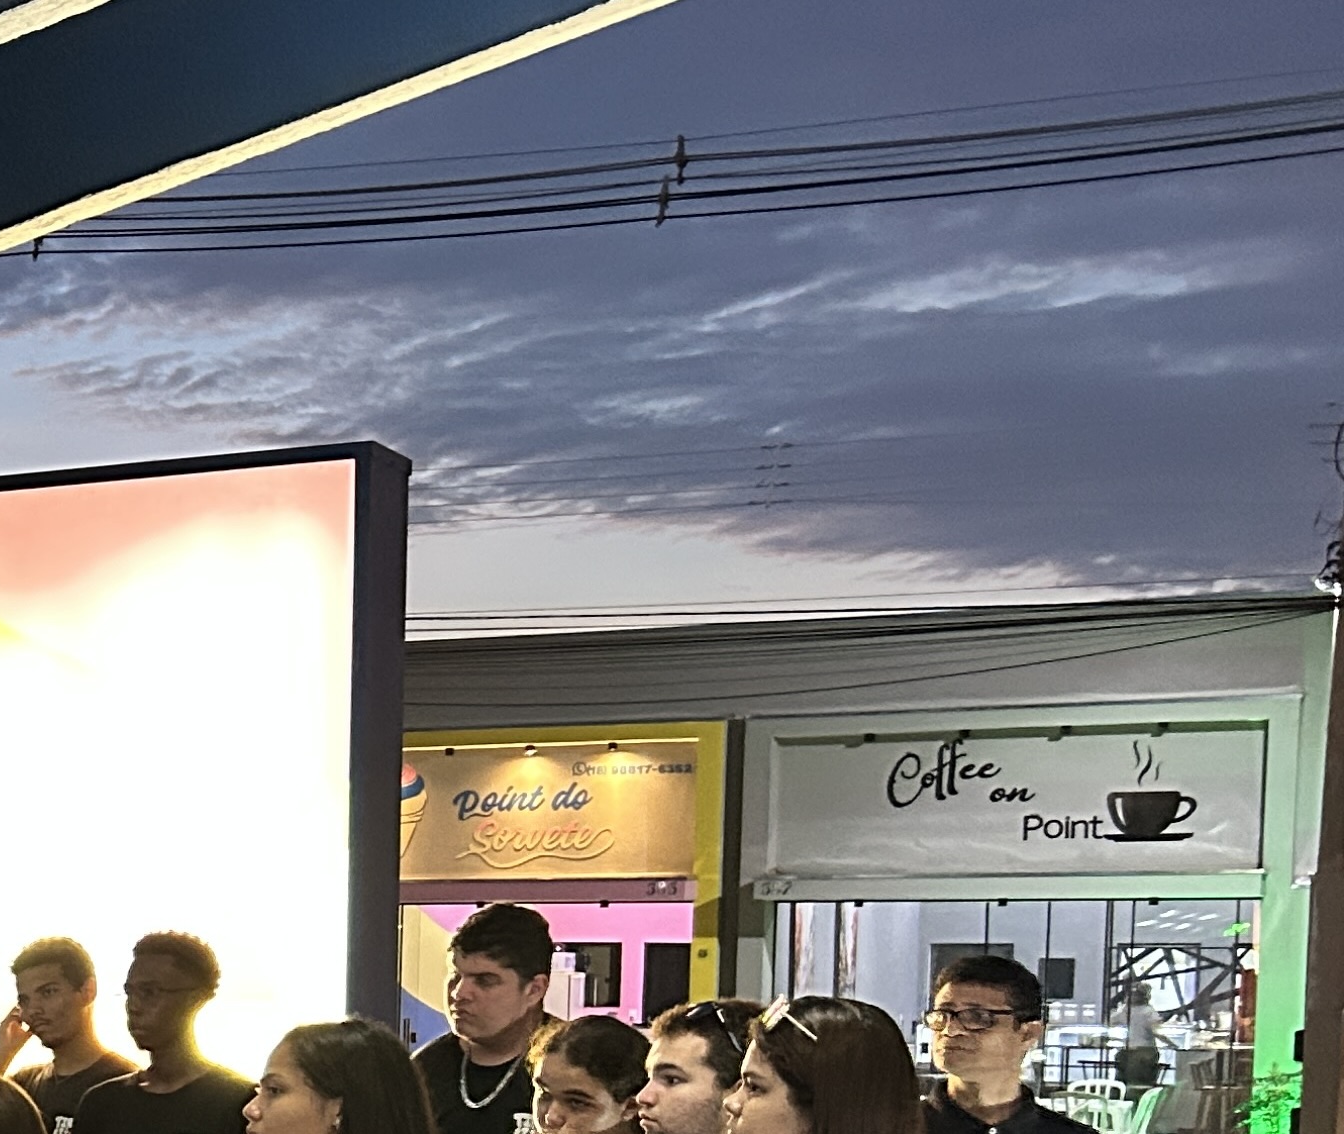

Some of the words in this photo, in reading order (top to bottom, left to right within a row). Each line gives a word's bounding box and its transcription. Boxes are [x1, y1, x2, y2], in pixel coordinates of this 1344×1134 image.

[886, 739, 1003, 808] Coffee
[453, 783, 545, 821] Point
[988, 783, 1037, 803] on
[468, 818, 614, 852] Sorvete
[1022, 814, 1104, 842] Point
